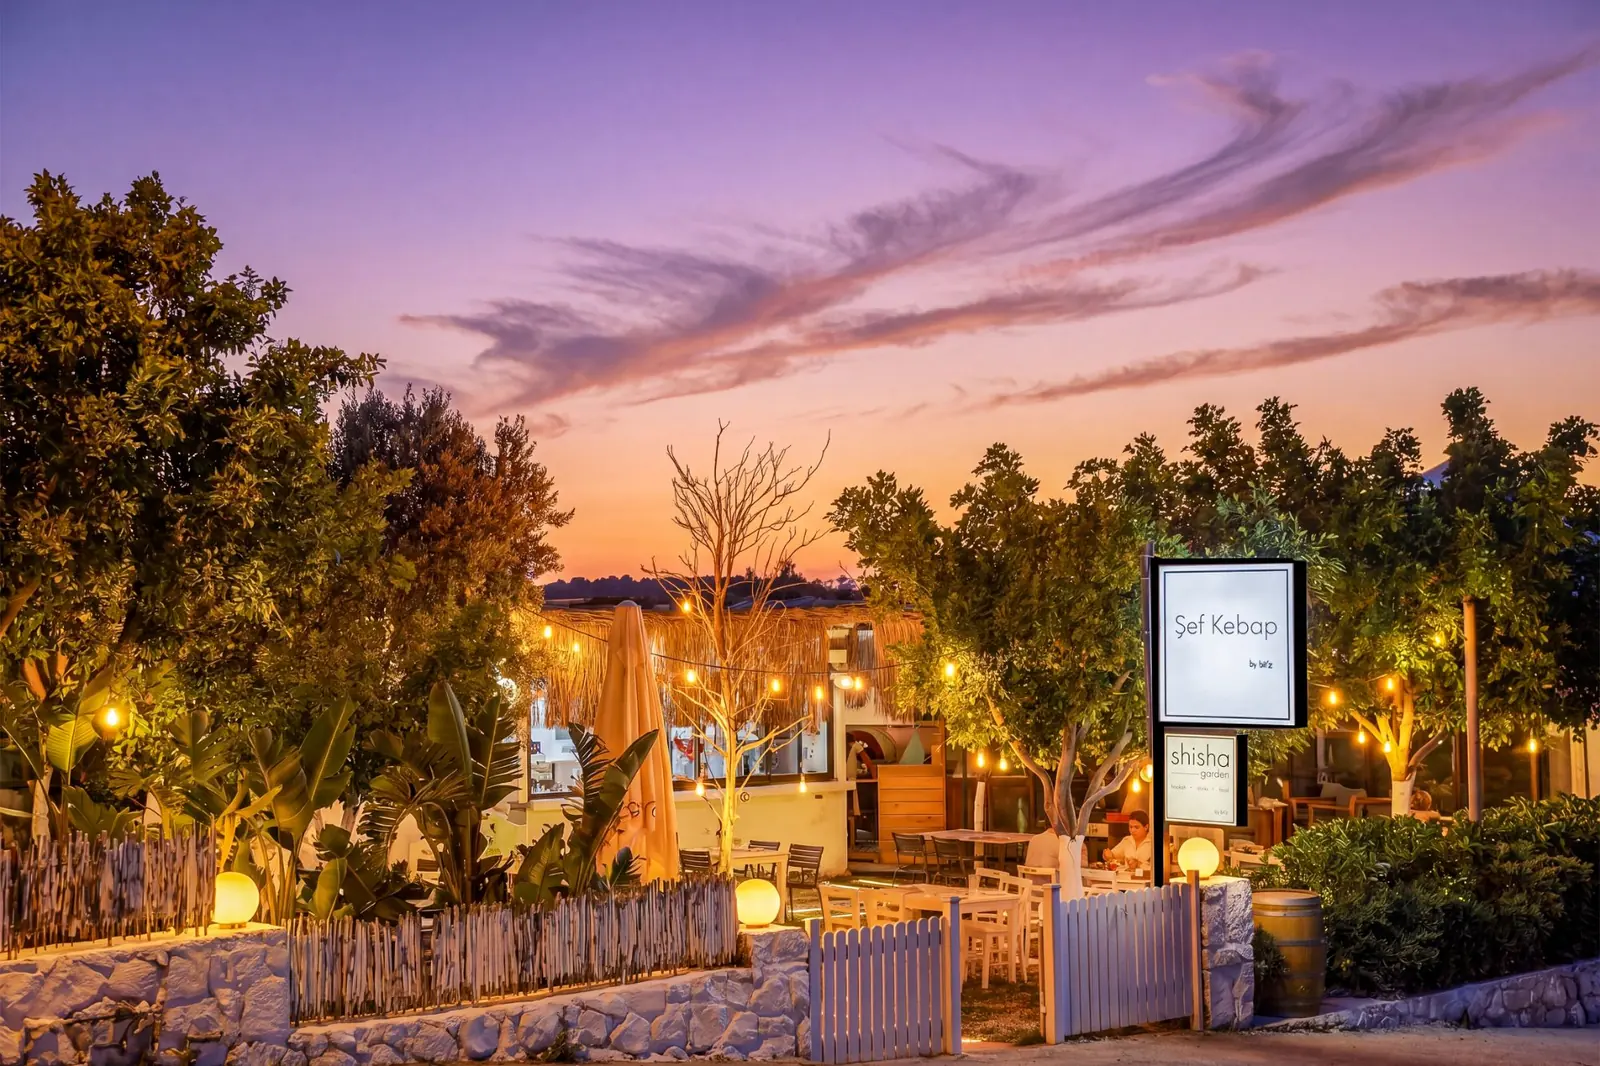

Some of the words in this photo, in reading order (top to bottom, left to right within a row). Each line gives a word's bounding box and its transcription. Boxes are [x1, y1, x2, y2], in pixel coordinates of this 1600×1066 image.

[1175, 613, 1205, 639] Şef
[1212, 613, 1278, 640] Kebap
[1249, 658, 1257, 670] by
[1171, 742, 1230, 768] shisha
[1200, 768, 1230, 780] garden
